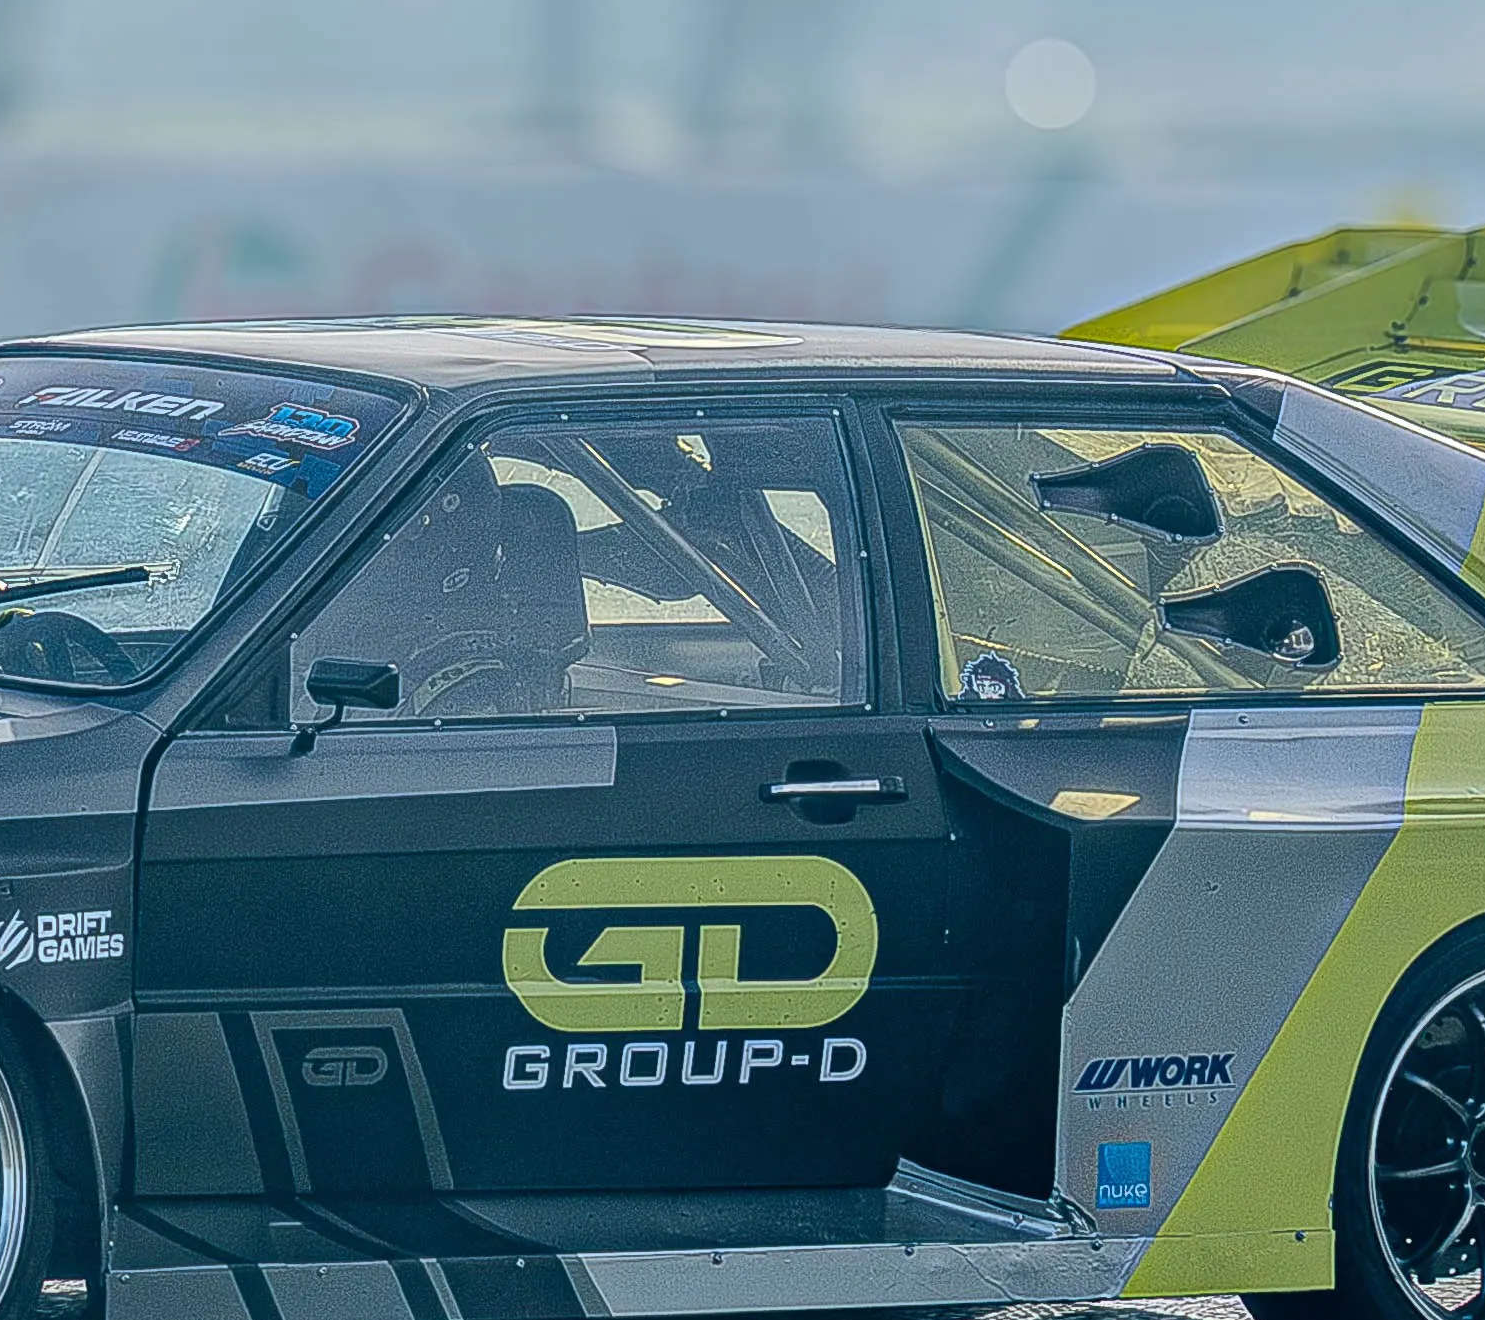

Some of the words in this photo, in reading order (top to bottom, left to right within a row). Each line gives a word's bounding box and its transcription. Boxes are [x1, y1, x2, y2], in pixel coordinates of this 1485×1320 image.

[18, 386, 225, 421] FALKEN
[37, 910, 111, 937] DRIFT
[38, 933, 124, 963] GAMES
[502, 855, 879, 1032] GD
[502, 1038, 867, 1090] GROUP-D
[1130, 1053, 1236, 1089] WORK
[1087, 1090, 1219, 1110] WHEELS
[1099, 1182, 1149, 1199] nuke
